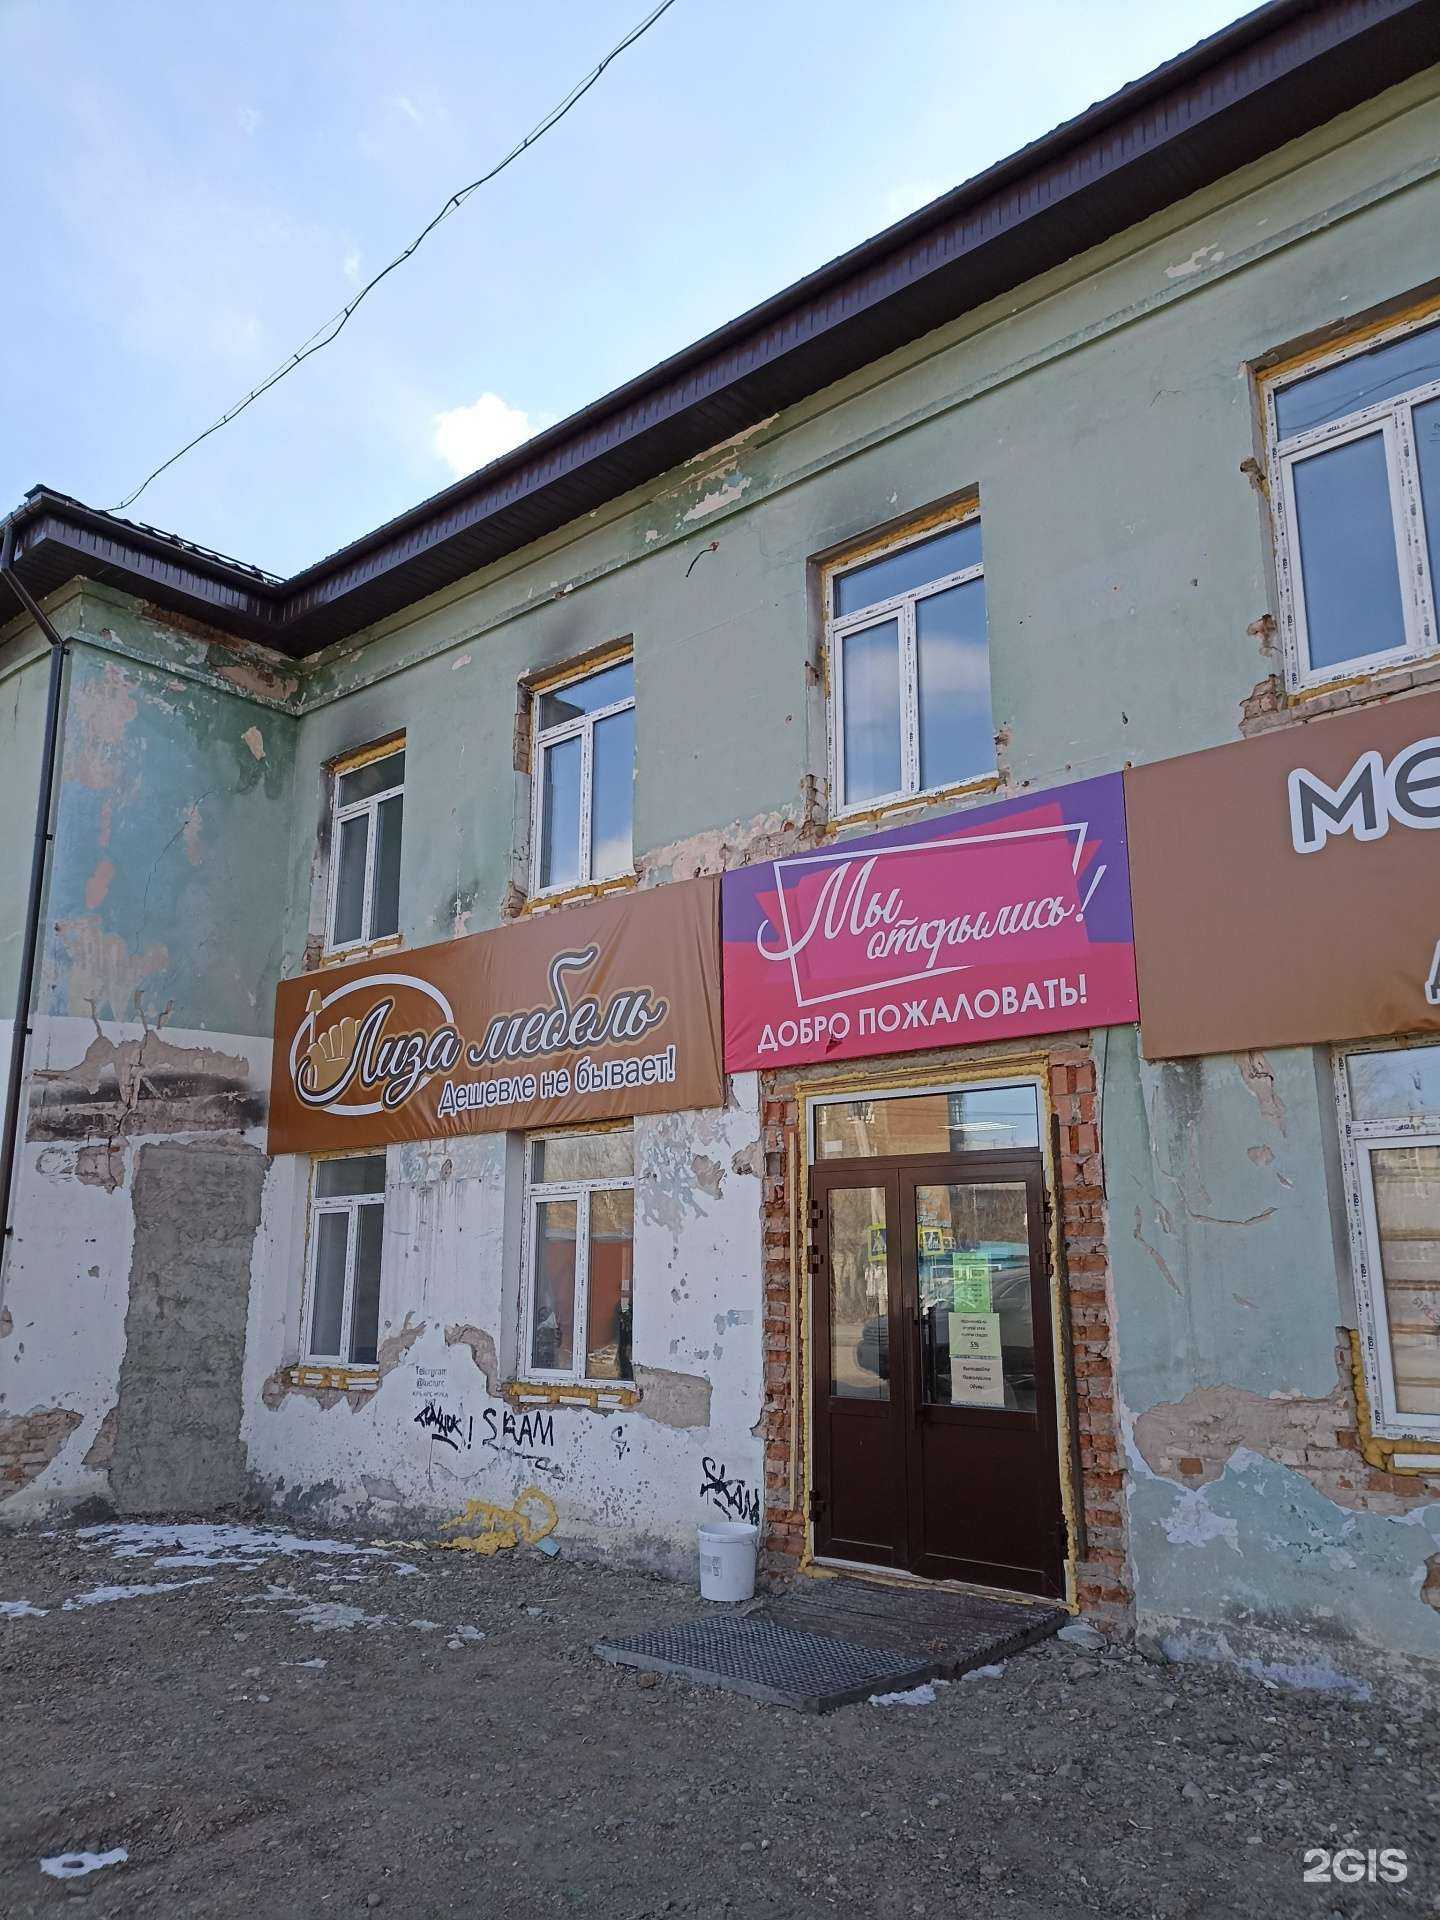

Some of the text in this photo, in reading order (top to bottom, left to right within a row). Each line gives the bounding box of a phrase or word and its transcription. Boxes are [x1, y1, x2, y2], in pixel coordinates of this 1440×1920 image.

[756, 856, 903, 961] Мы
[866, 865, 1107, 969] открылись!
[296, 945, 668, 1106] Лиза мебель
[757, 973, 1088, 1054] ДОБРО ПОЖАЛОВАТЬ!
[438, 1045, 677, 1118] Дешевле не бывает!
